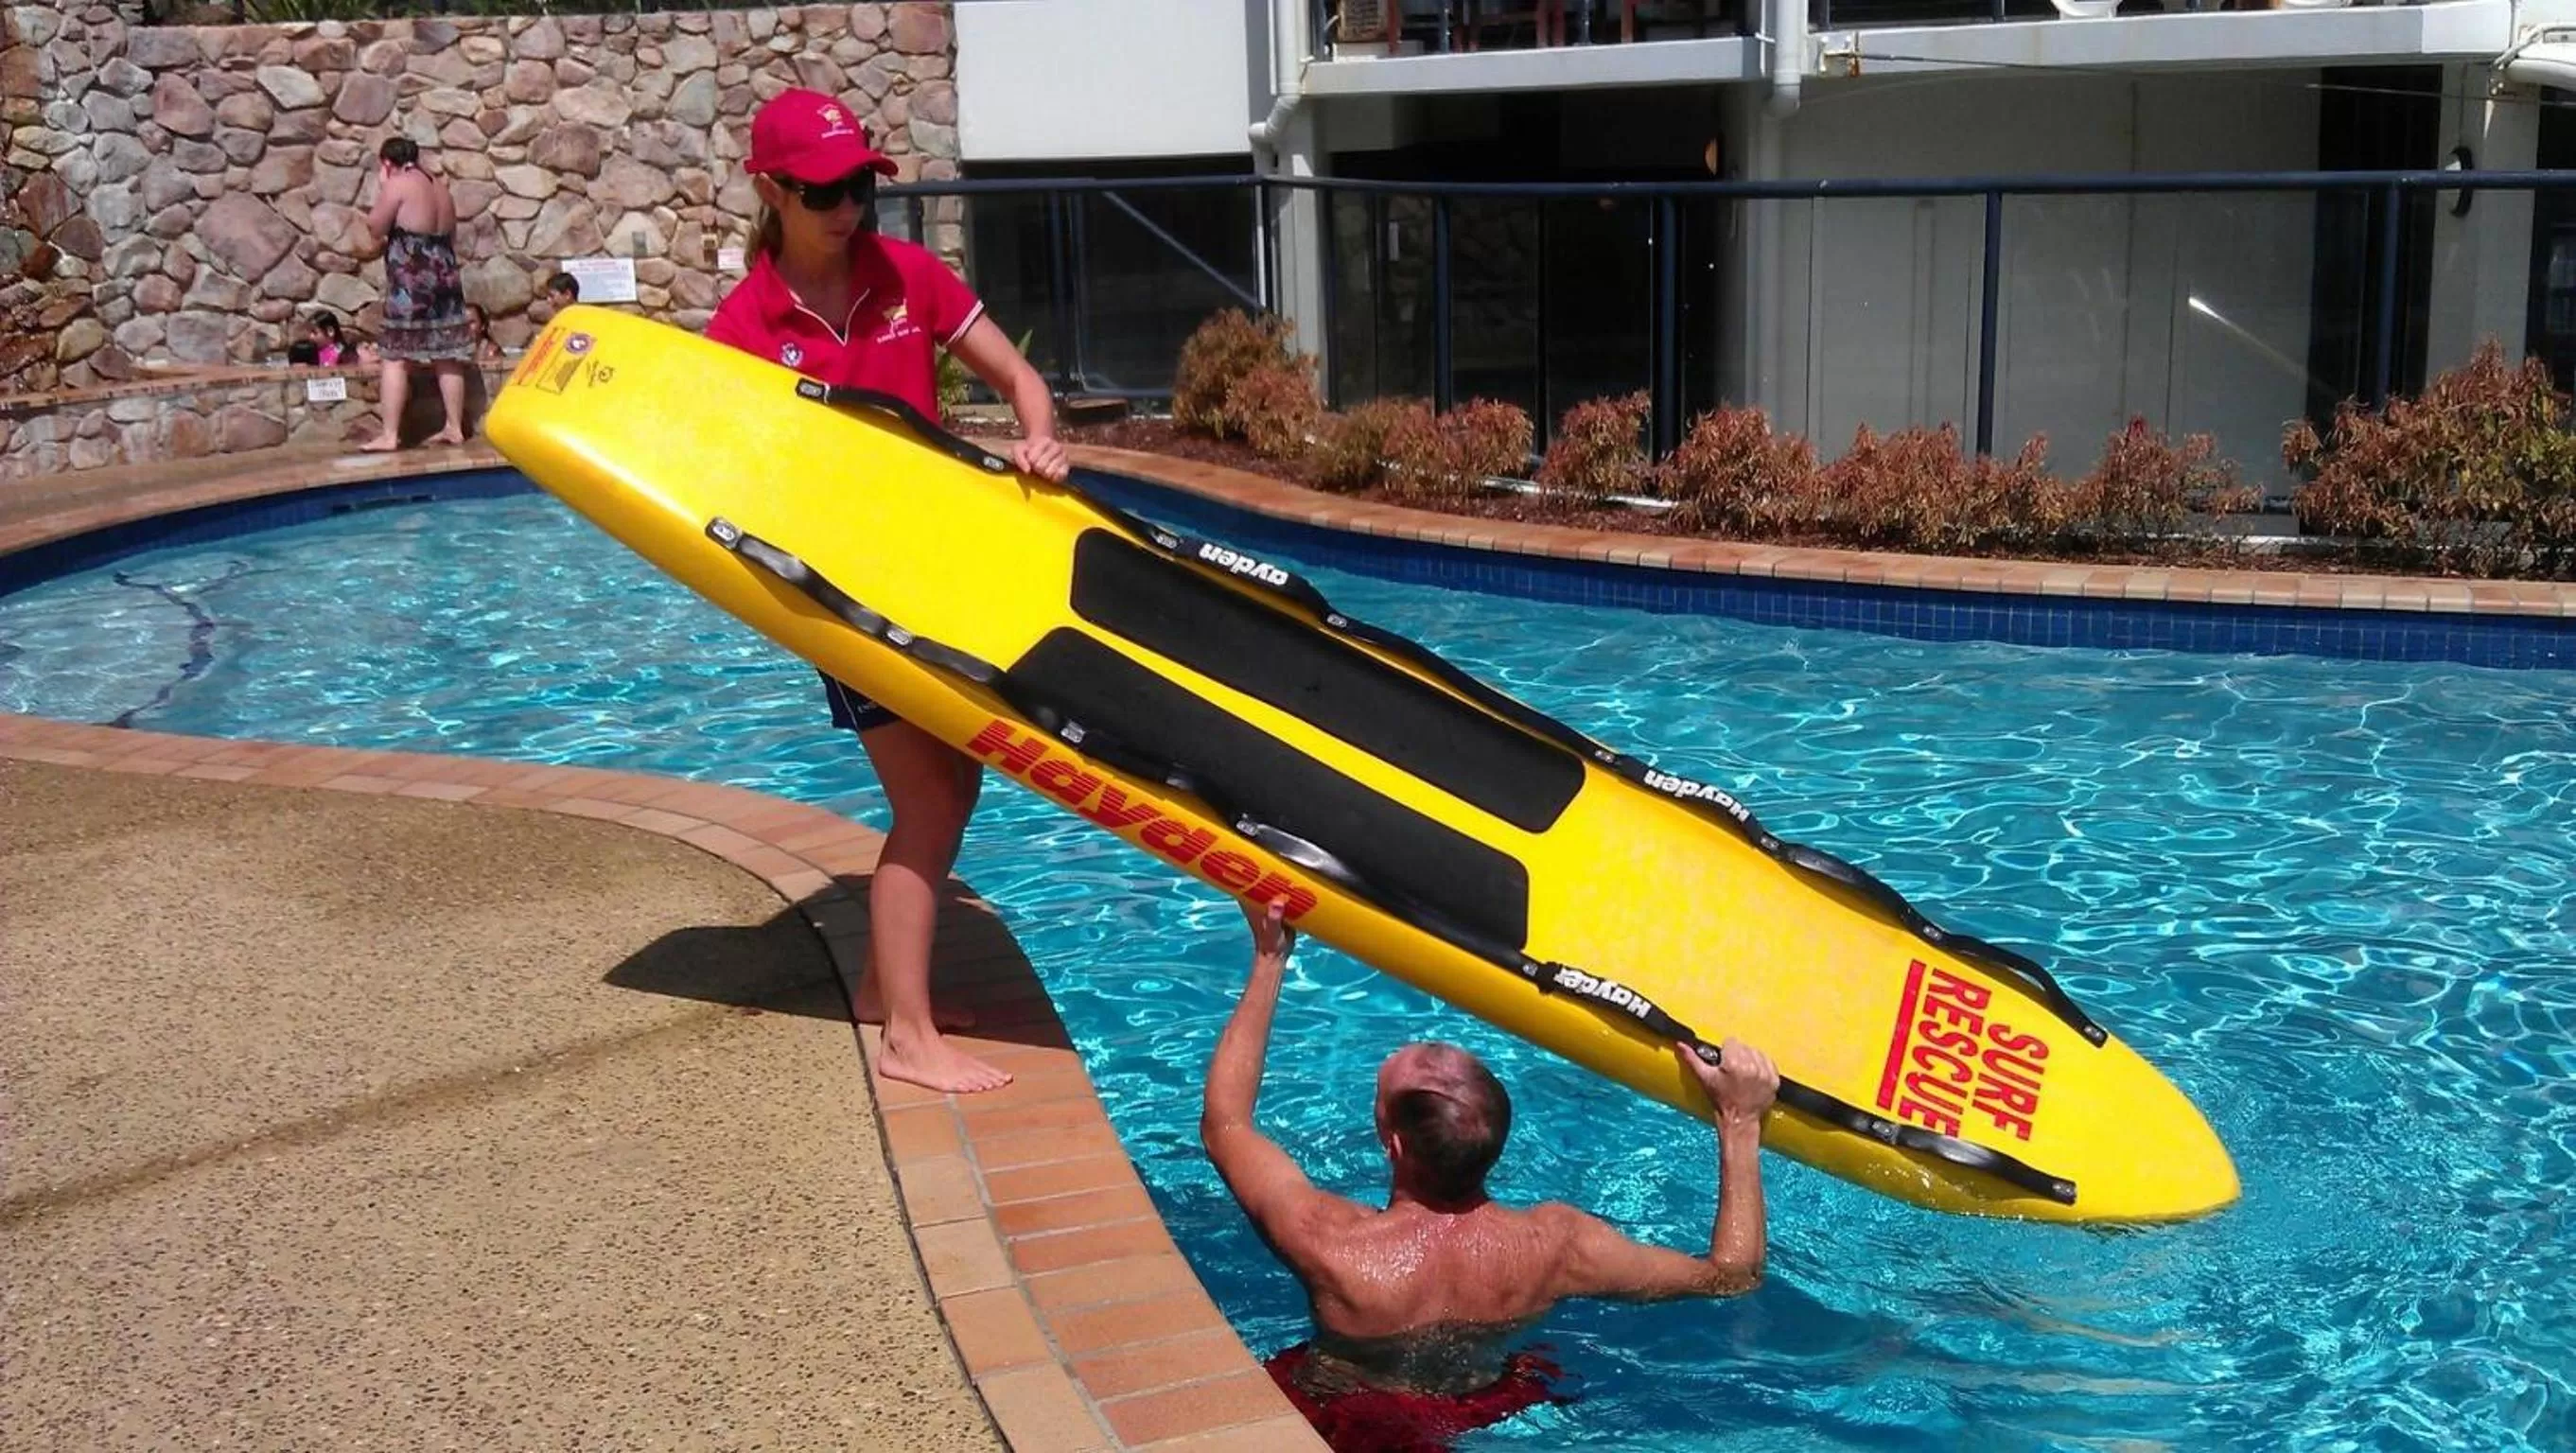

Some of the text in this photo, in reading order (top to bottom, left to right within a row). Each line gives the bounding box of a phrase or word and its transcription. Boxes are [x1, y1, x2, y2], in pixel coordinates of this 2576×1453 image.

[1199, 543, 1288, 586] ayden
[966, 719, 1318, 920] Hayden
[1643, 770, 1750, 822] Hayden
[1898, 968, 1991, 1138] RESCUE
[1971, 1024, 2049, 1141] SURF
